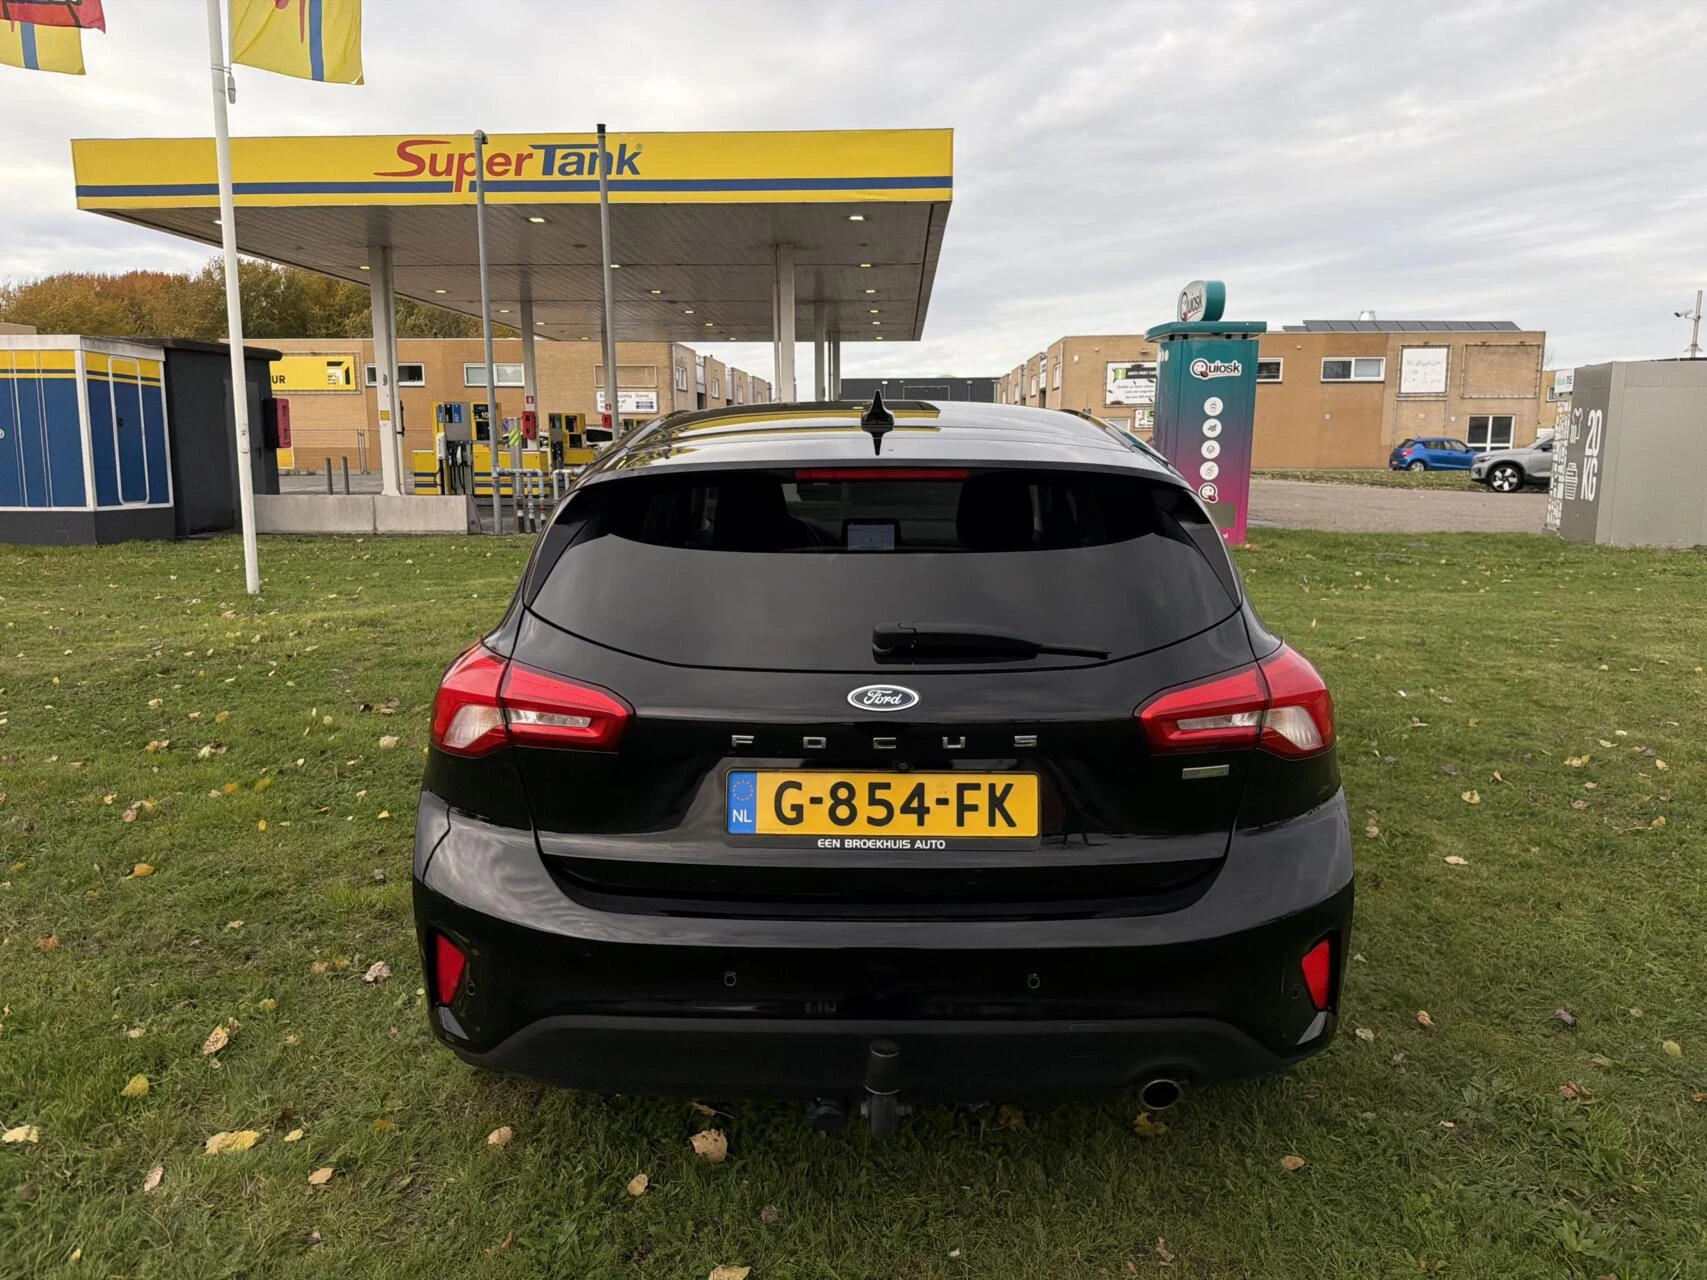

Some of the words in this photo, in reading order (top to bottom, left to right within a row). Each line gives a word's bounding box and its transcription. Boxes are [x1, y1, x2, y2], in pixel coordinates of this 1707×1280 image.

[1191, 360, 1241, 378] Quiosk
[1585, 409, 1603, 457] 20
[1580, 457, 1598, 501] KG
[863, 689, 903, 705] Ford
[732, 735, 1037, 749] FOCUS
[773, 780, 1017, 828] G-854-FK
[732, 808, 753, 823] NL
[817, 838, 841, 849] EEN
[844, 839, 911, 850] BROEKHUIS
[914, 839, 946, 850] AUTO
